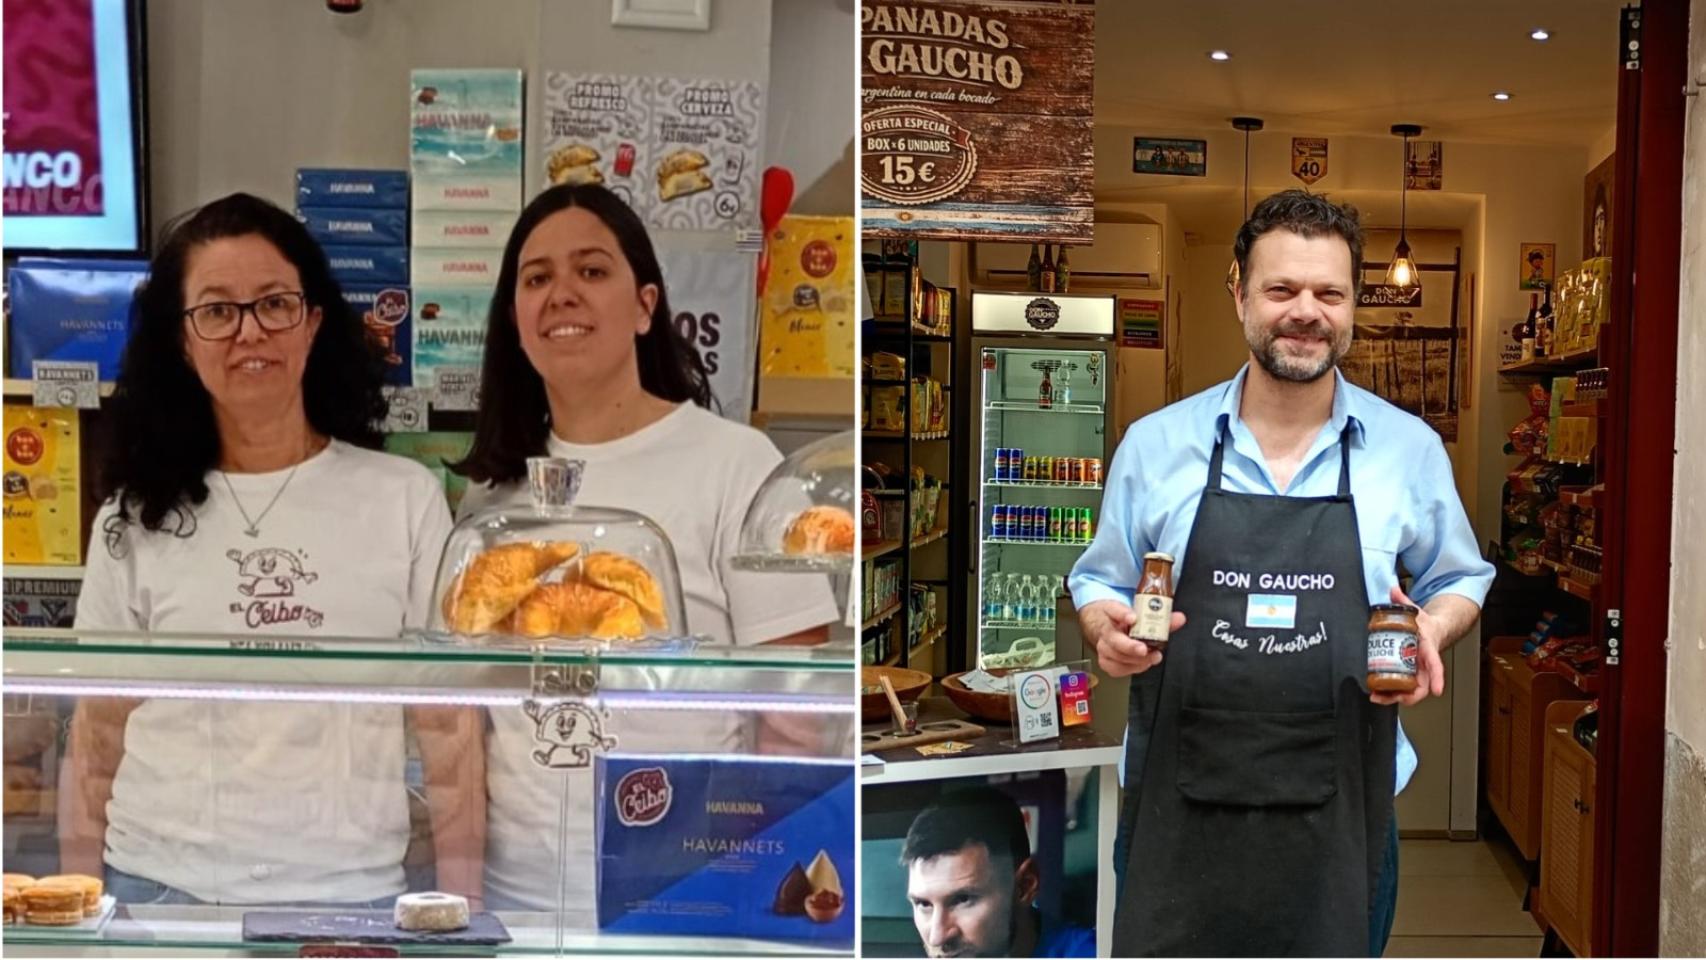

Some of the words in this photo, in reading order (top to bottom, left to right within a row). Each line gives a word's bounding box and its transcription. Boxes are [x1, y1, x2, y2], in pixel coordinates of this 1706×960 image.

[868, 39, 1023, 90] GAUCHO
[575, 82, 620, 97] PROMO
[684, 88, 730, 103] PROMO
[861, 86, 912, 103] argentina
[914, 90, 930, 98] en
[930, 88, 955, 101] cada
[958, 89, 1002, 104] bocado
[680, 102, 734, 117] CERVEZA
[863, 118, 902, 132] OFERTA
[904, 117, 951, 135] ESPECIAL
[867, 138, 891, 151] BOX
[898, 139, 906, 151] 6
[907, 139, 951, 152] UNIDADES
[1299, 161, 1320, 176] 40
[418, 329, 484, 346] HAVANN
[1213, 570, 1251, 588] DON
[1259, 573, 1335, 590] GAUCHO
[705, 801, 764, 815] HAVANNA
[683, 837, 785, 856] HAVANNETS
